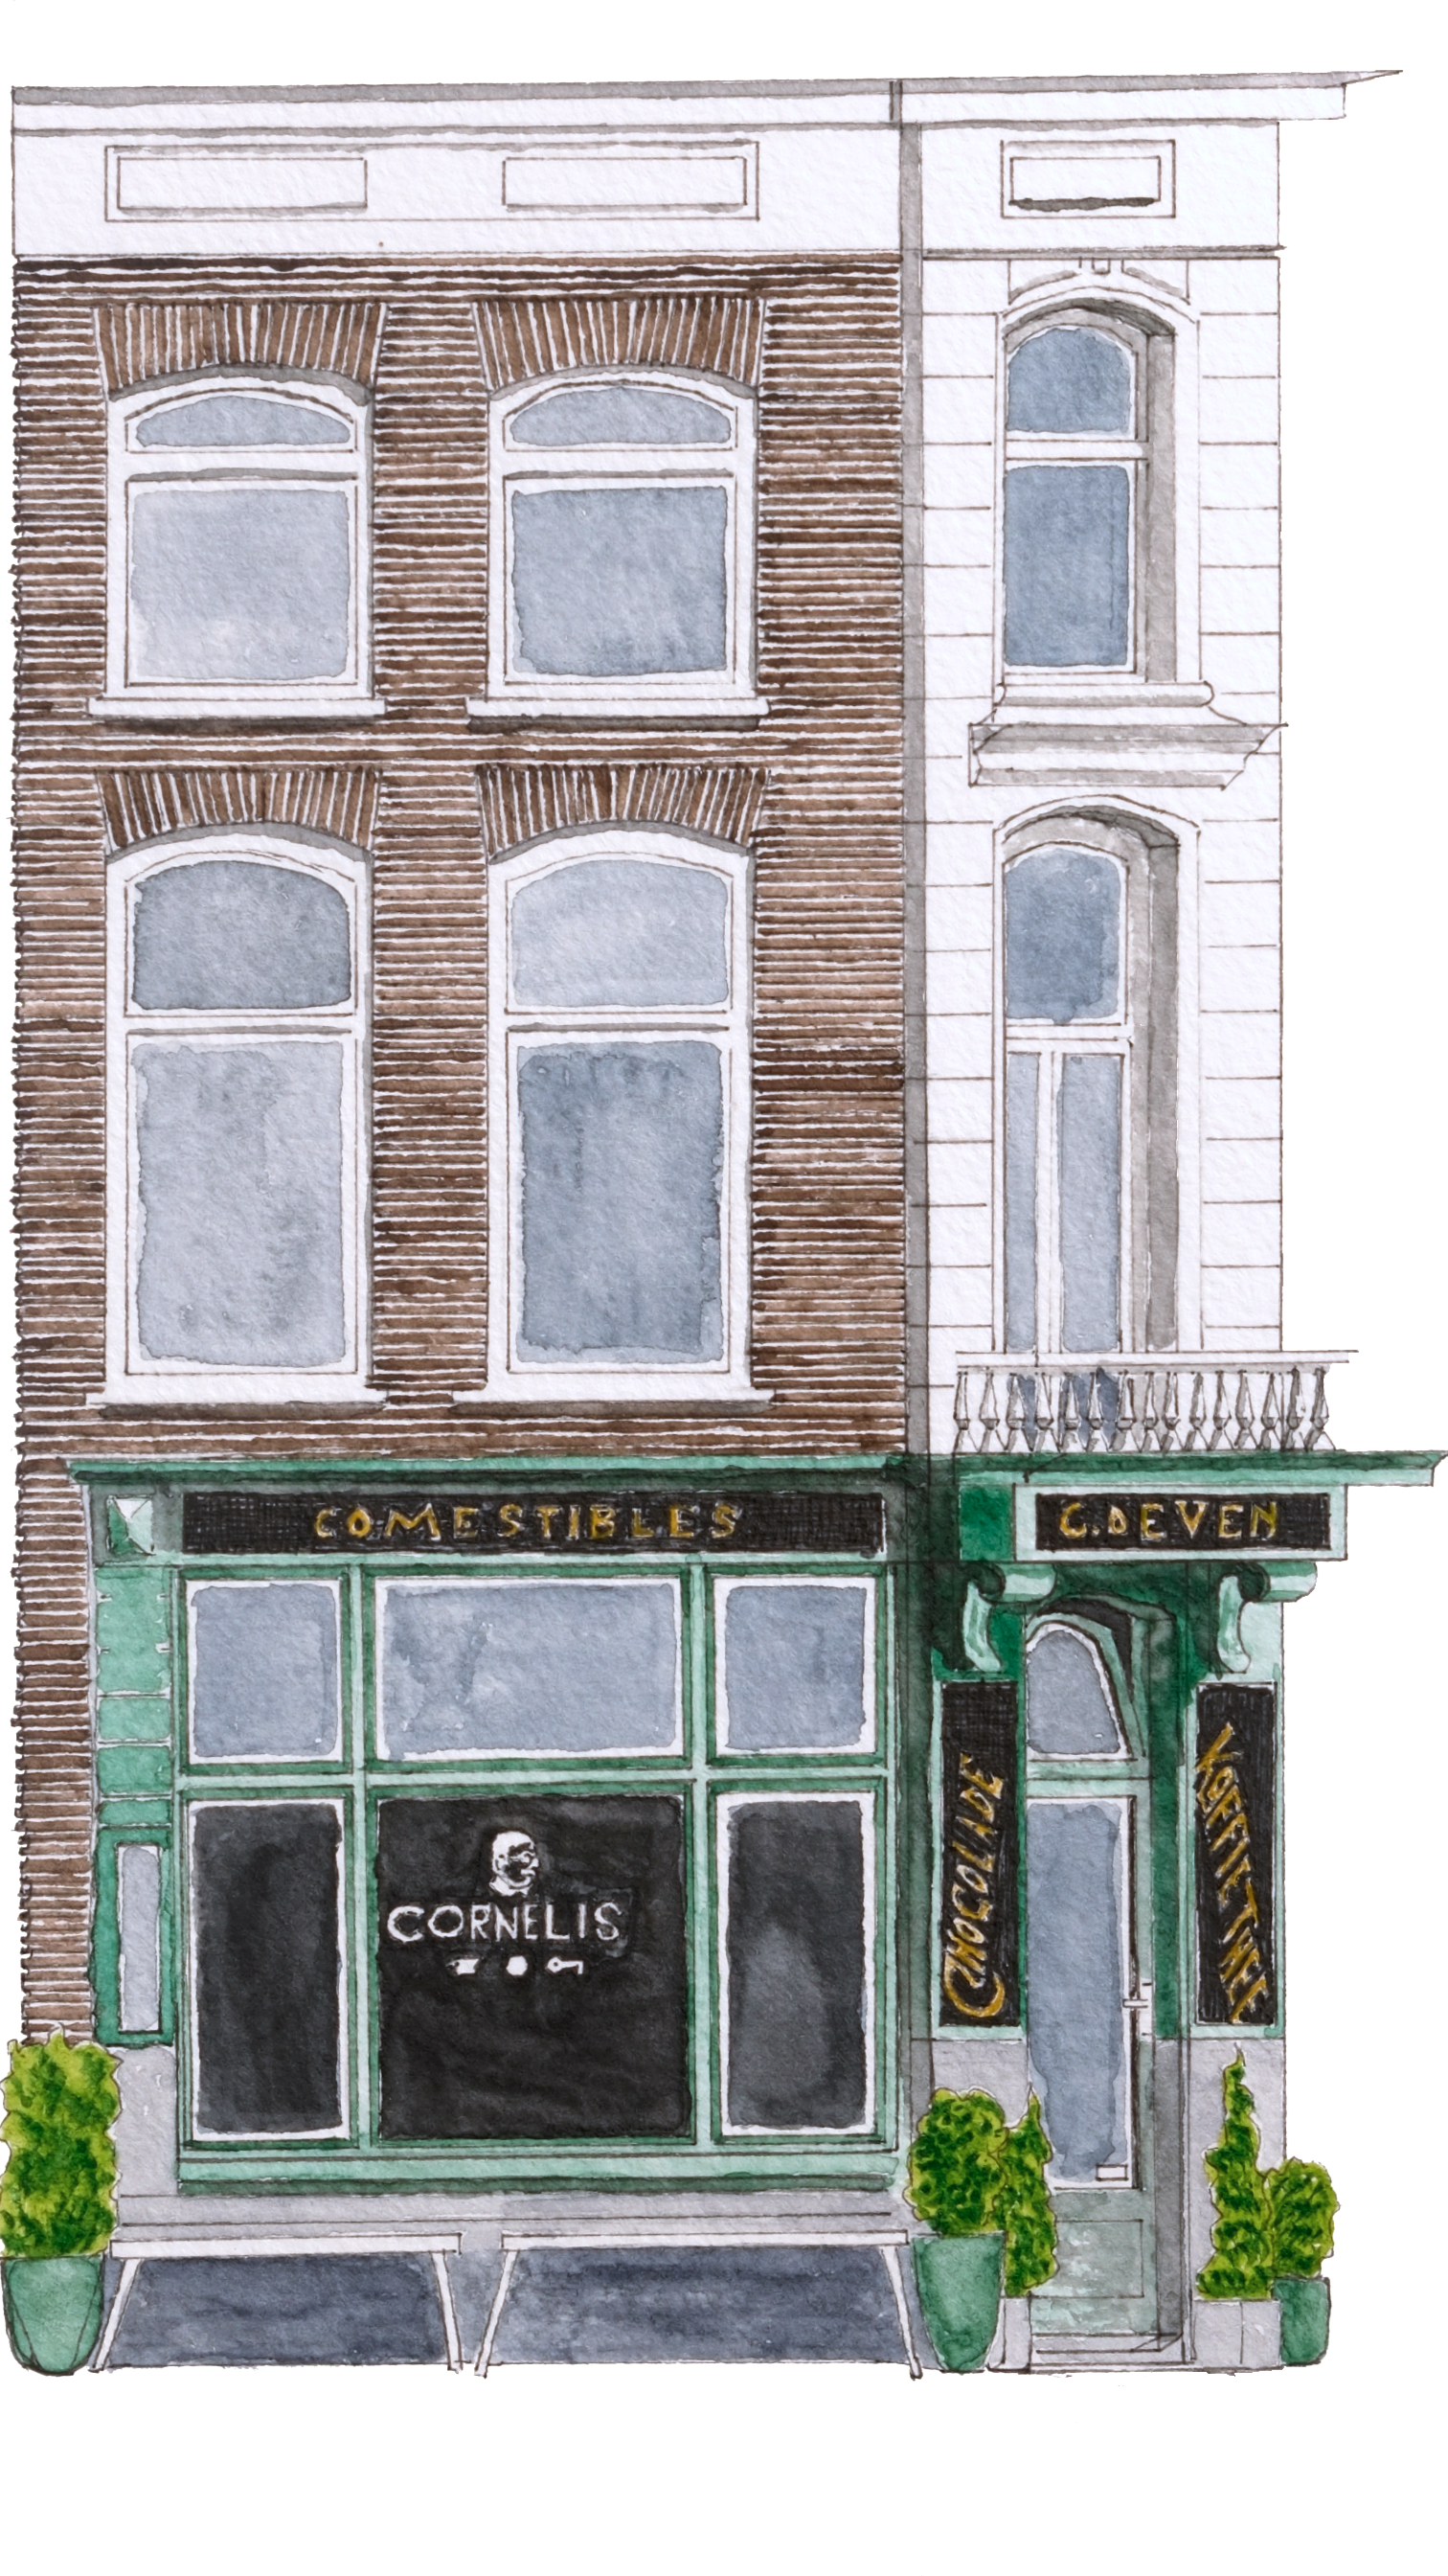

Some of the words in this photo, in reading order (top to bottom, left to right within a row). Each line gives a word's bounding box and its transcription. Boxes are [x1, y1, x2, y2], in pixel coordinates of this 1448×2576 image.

[313, 1503, 741, 1540] COMESTIBLES
[943, 1751, 1005, 2017] CHOCOLADE
[387, 1903, 622, 1943] CORNELIS
